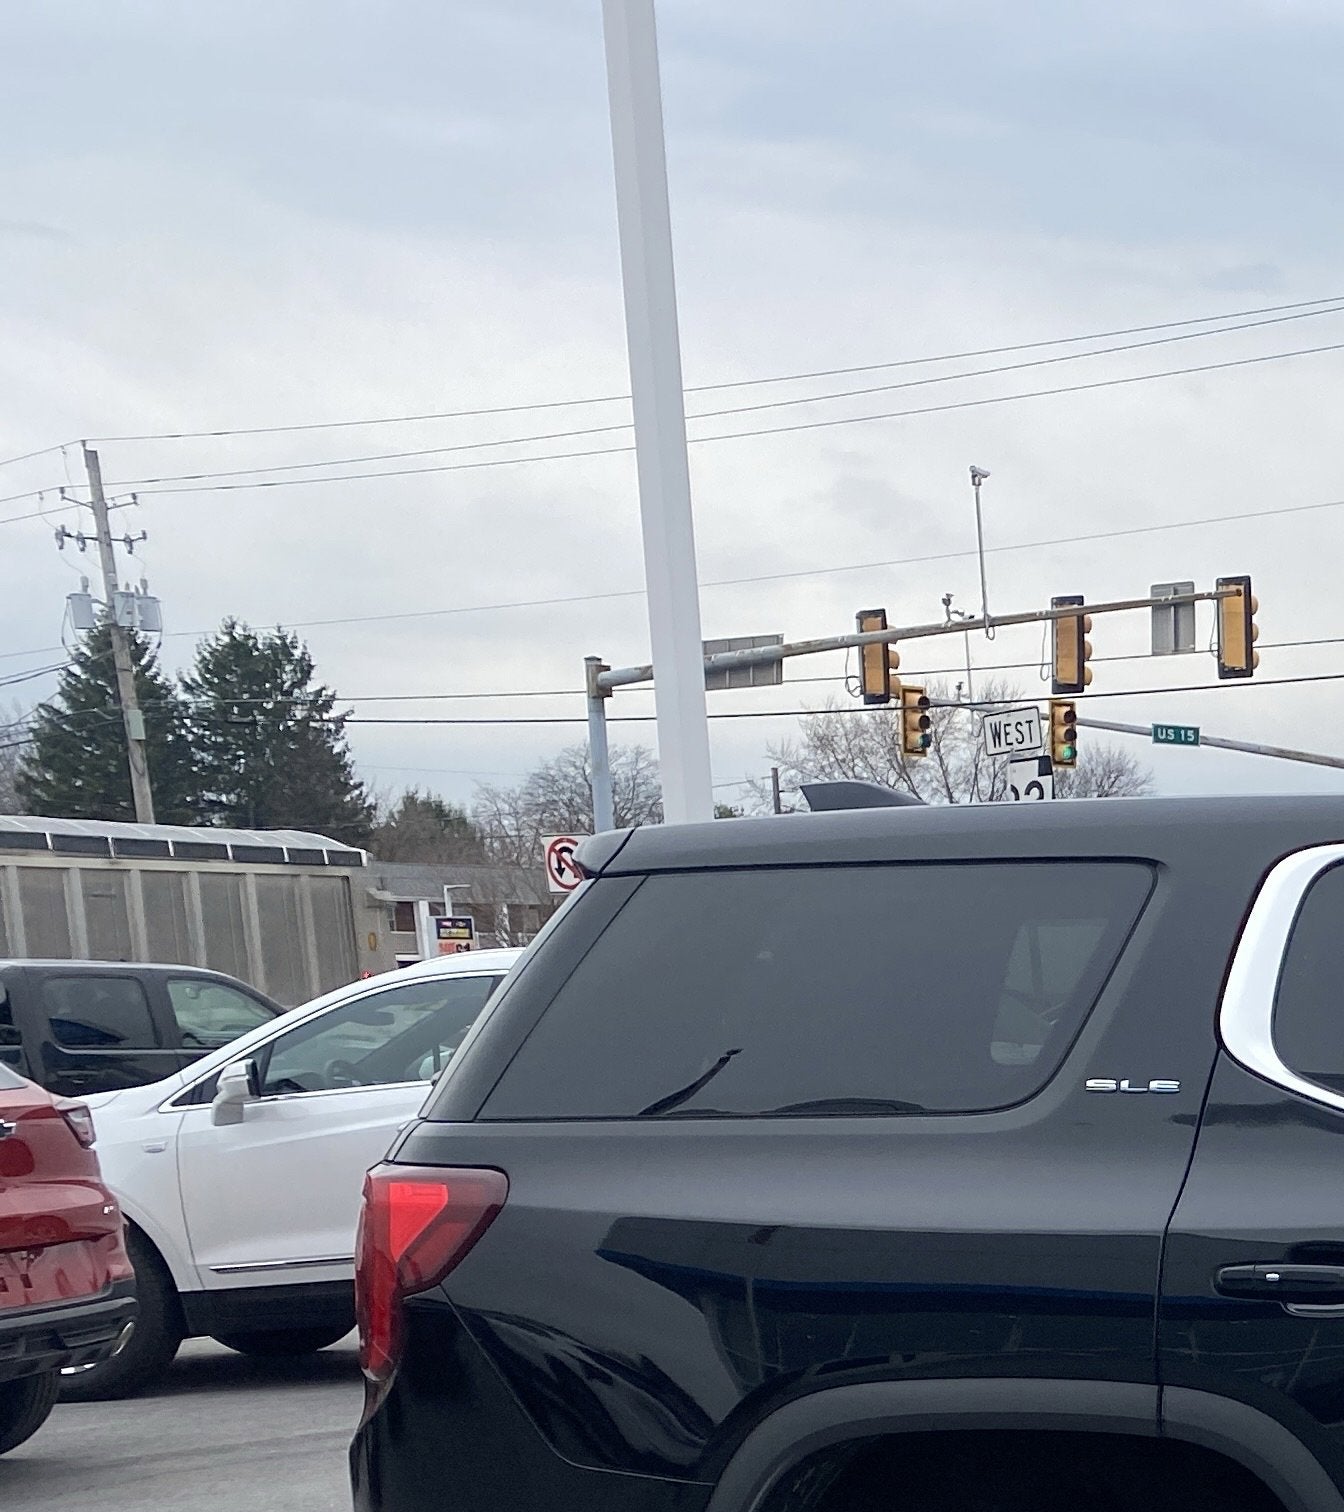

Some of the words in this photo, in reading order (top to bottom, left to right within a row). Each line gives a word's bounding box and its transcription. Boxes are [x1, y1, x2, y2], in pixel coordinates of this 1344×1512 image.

[989, 719, 1034, 749] WEST
[1157, 727, 1175, 740] US
[1180, 729, 1195, 742] 15
[1085, 1078, 1181, 1093] SLE
